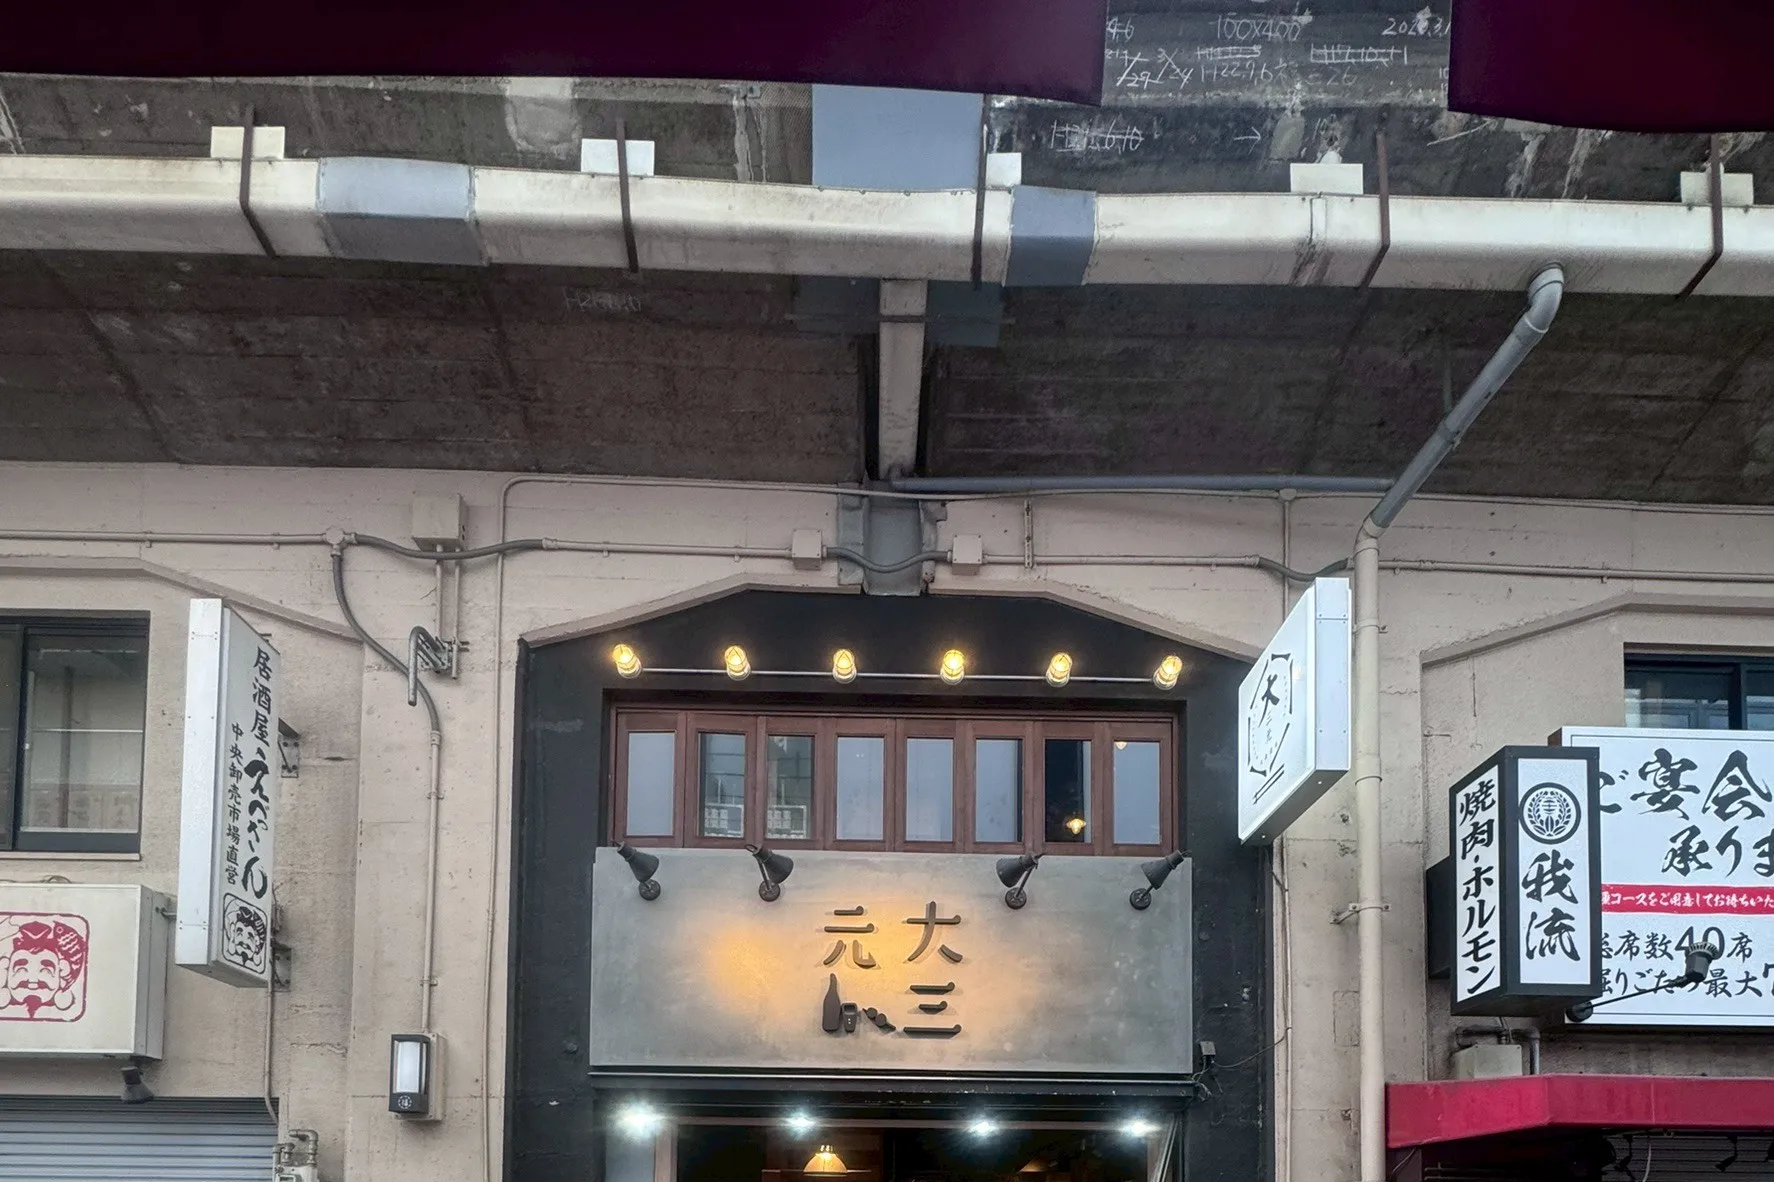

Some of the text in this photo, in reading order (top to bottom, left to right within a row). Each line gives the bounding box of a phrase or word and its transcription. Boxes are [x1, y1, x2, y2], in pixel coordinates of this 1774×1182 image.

[223, 722, 244, 885] 中央卸売市場直営
[1521, 849, 1581, 962] 我流
